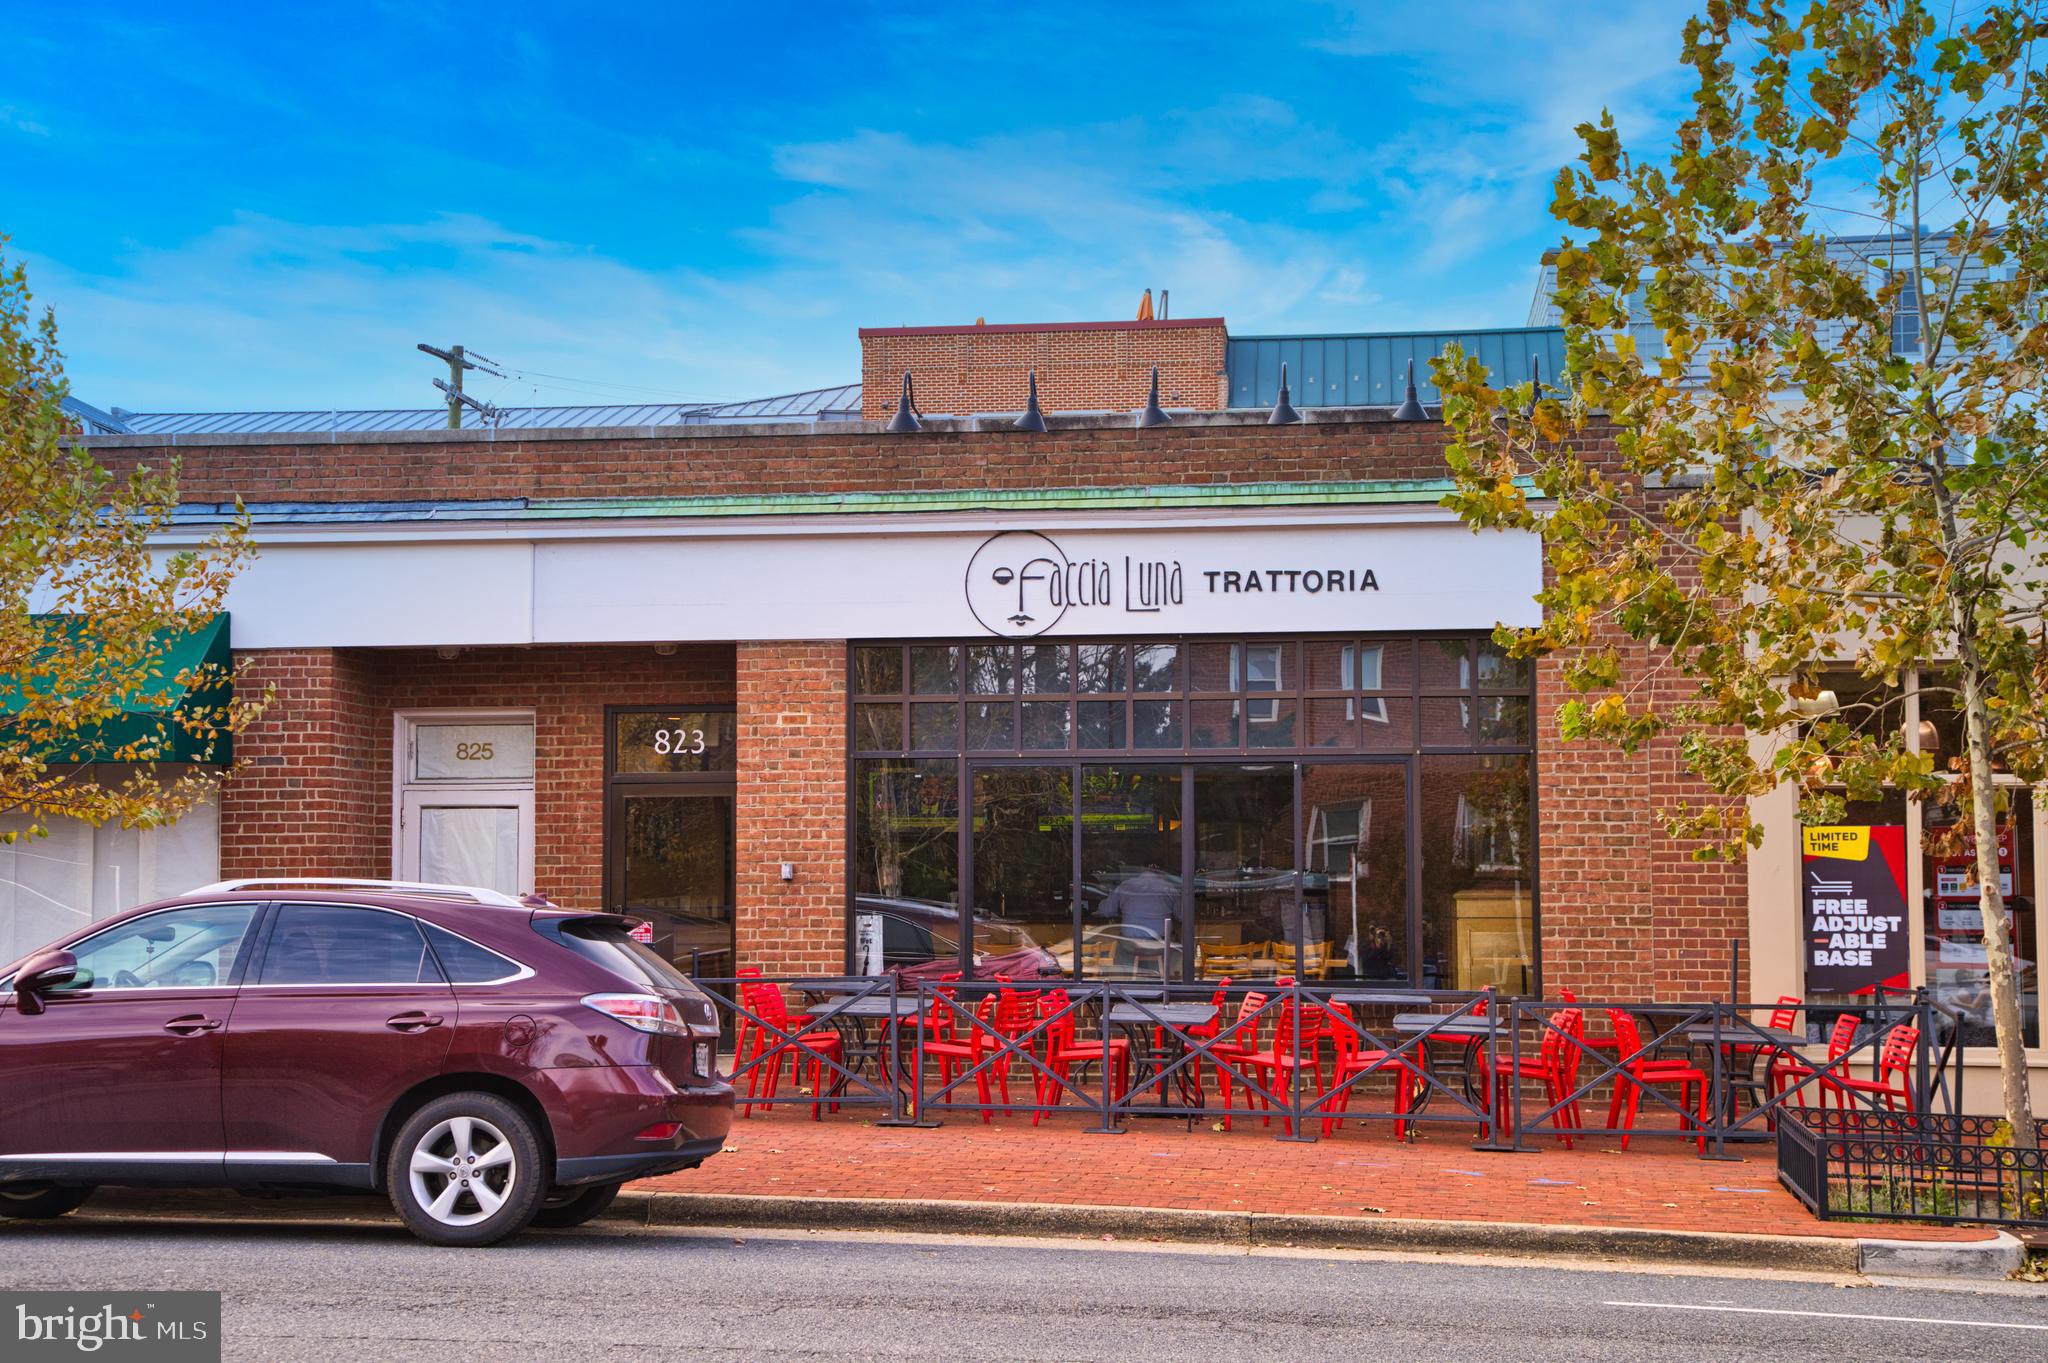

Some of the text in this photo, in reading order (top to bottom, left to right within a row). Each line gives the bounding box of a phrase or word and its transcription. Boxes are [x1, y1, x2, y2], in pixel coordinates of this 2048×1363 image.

[1019, 556, 1379, 612] Faccia Luna TRATTORIA
[654, 729, 705, 755] 823
[456, 742, 495, 761] 825
[1809, 832, 1858, 841] LIMITED
[1809, 842, 1839, 852] TIME
[1812, 899, 1868, 915] FREE
[1812, 916, 1902, 932] ADJUST
[1814, 950, 1873, 966] BASE
